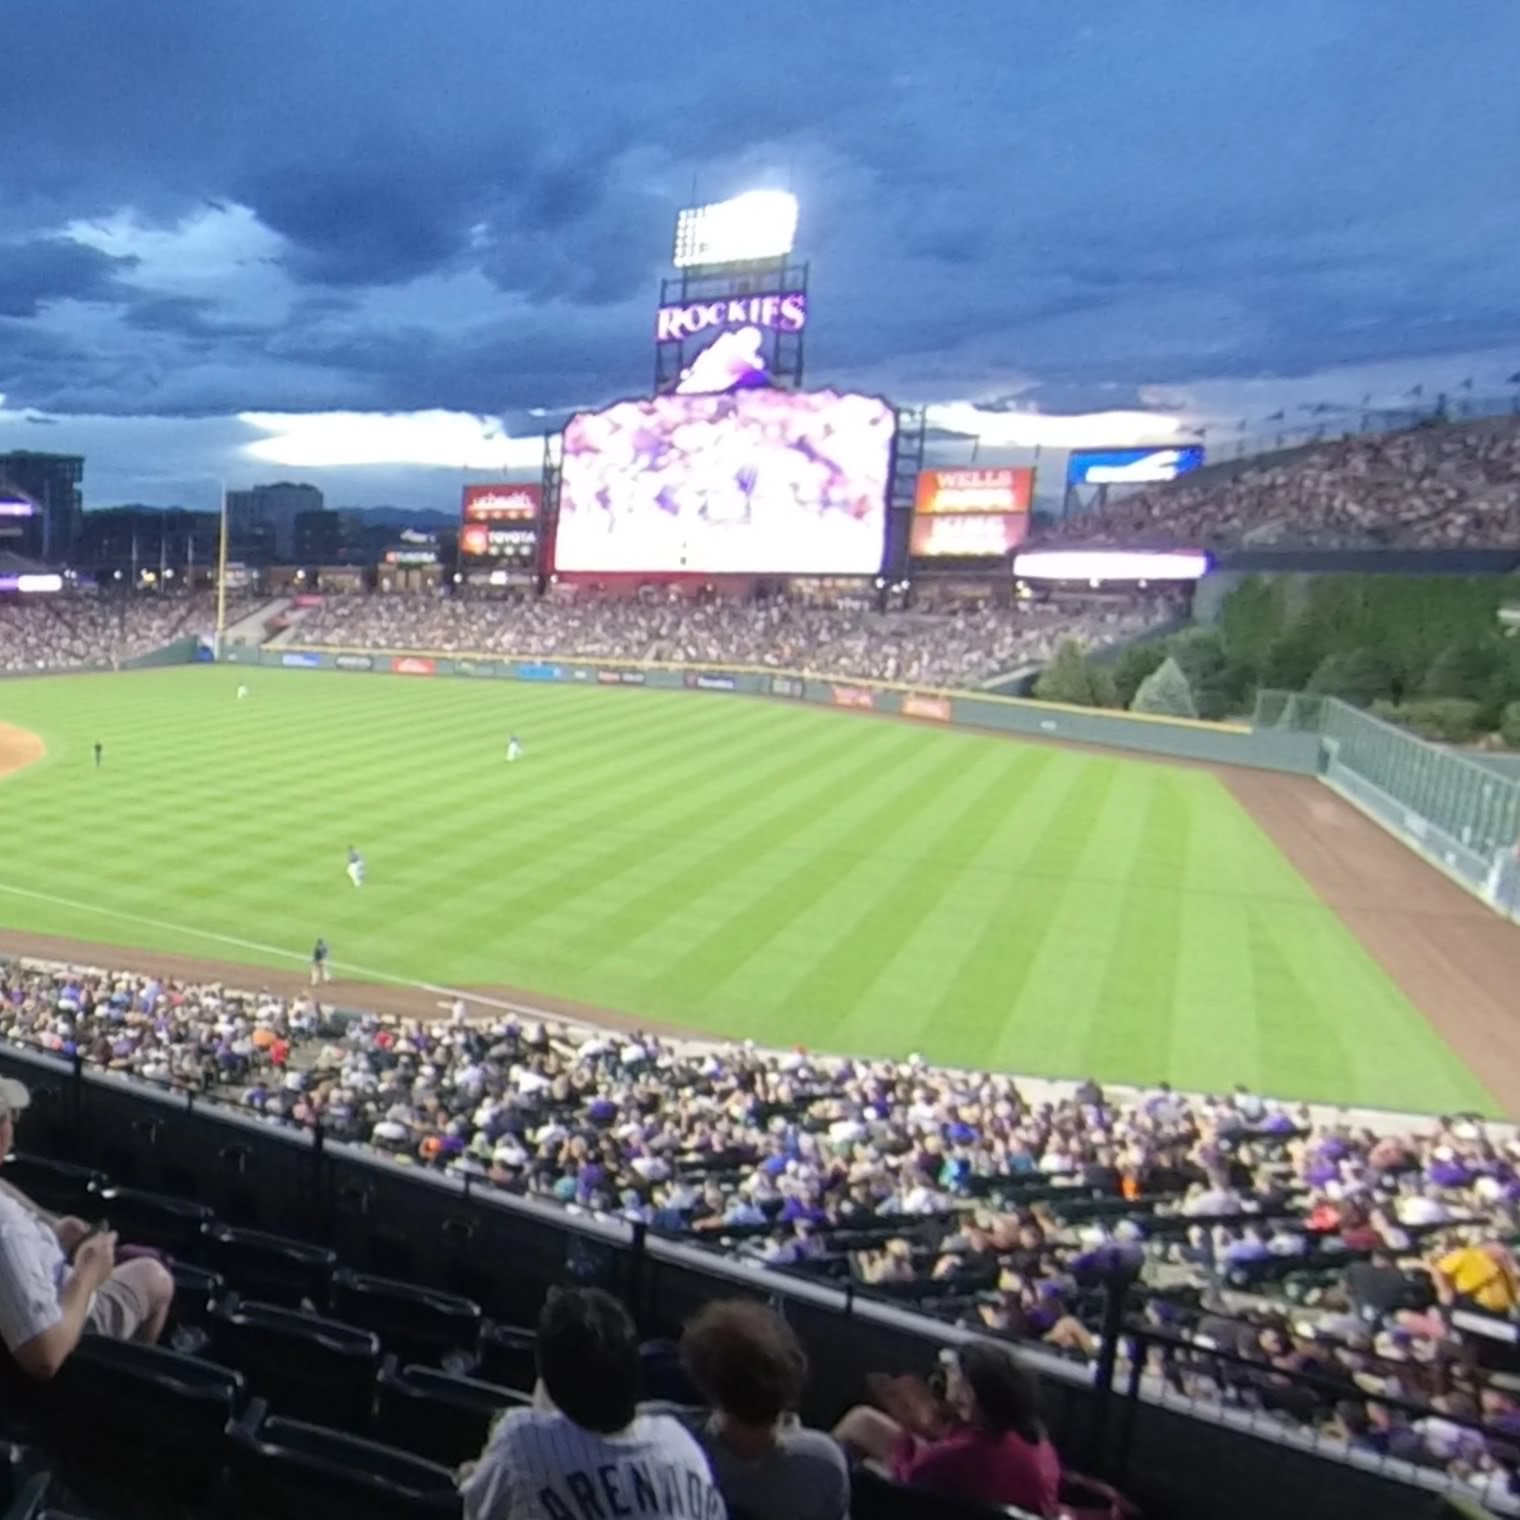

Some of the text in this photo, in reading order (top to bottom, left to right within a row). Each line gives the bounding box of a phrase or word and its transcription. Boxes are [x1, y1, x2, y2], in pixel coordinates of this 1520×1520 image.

[657, 293, 805, 340] ROCKIES
[936, 470, 1013, 488] WELLS
[488, 530, 536, 544] TOYOTA
